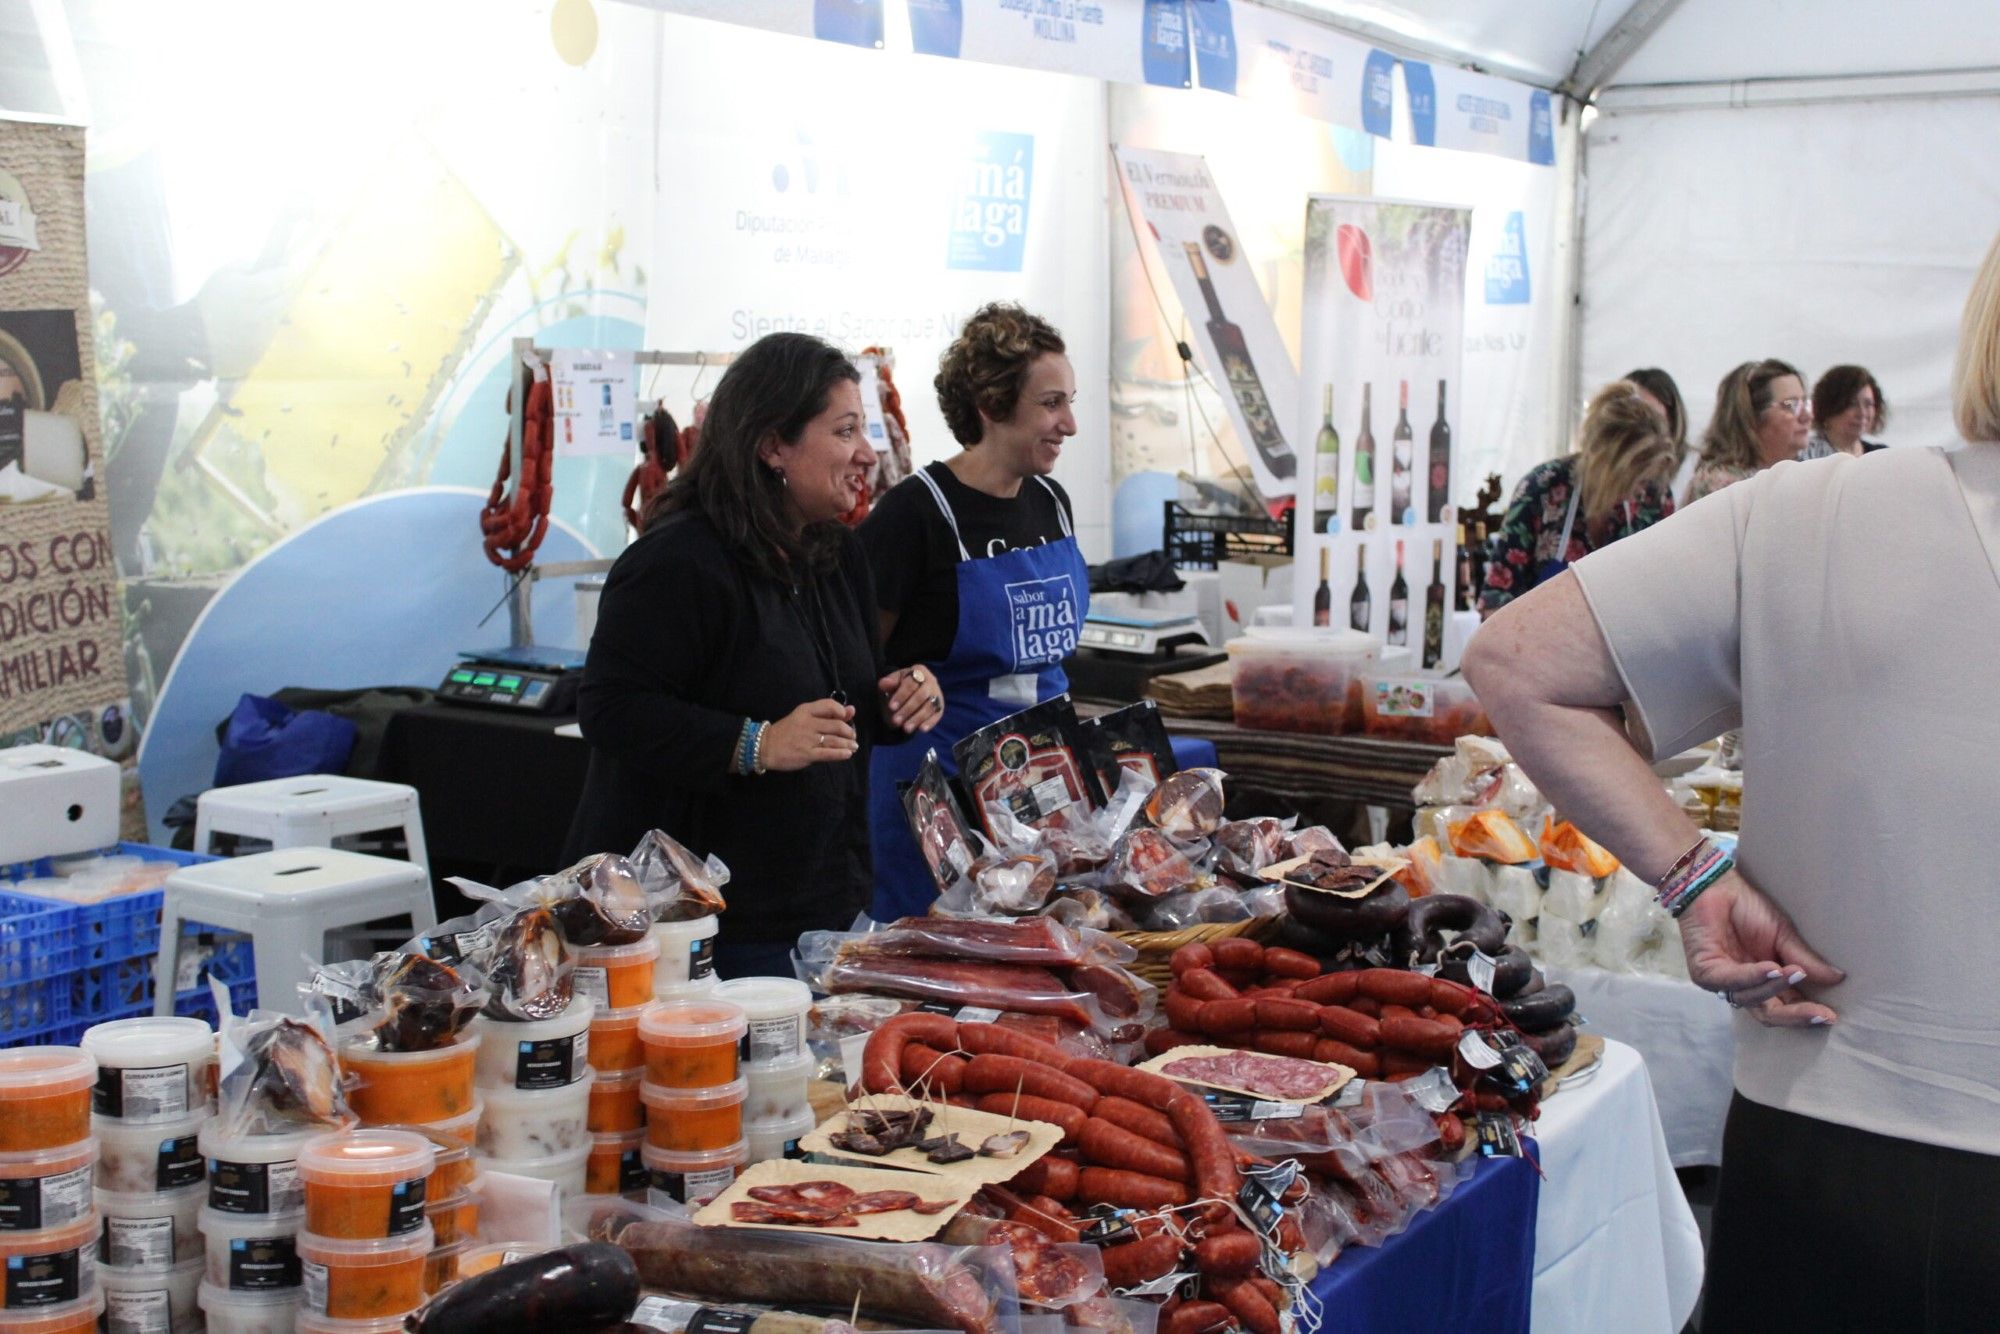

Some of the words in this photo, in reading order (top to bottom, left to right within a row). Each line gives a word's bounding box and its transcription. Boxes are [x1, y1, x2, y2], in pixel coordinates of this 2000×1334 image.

[1013, 589, 1045, 605] sabor
[1016, 606, 1025, 620] a
[1027, 587, 1075, 631] má
[1018, 624, 1077, 664] laga
